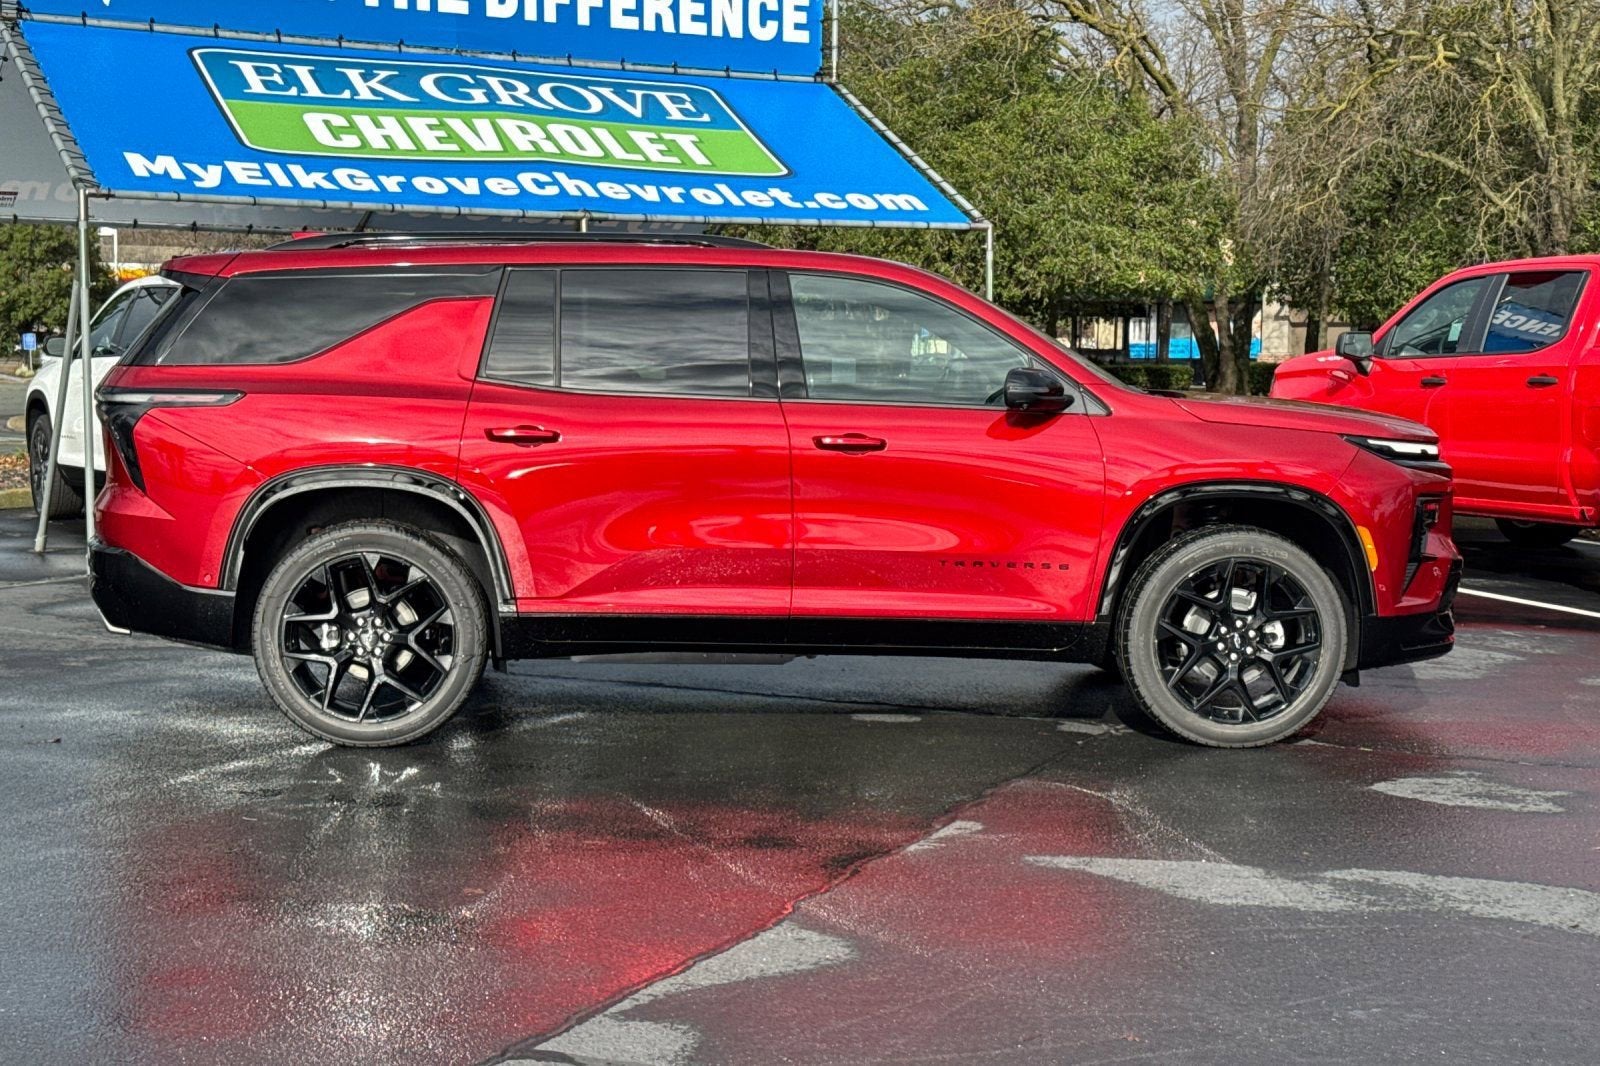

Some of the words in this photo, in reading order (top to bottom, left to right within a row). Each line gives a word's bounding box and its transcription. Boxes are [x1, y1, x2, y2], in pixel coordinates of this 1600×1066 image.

[229, 60, 417, 102] ELK
[420, 72, 711, 118] GROVE
[302, 112, 712, 166] CHEVROLET
[123, 152, 928, 213] MyElkGroveChevrolet.com
